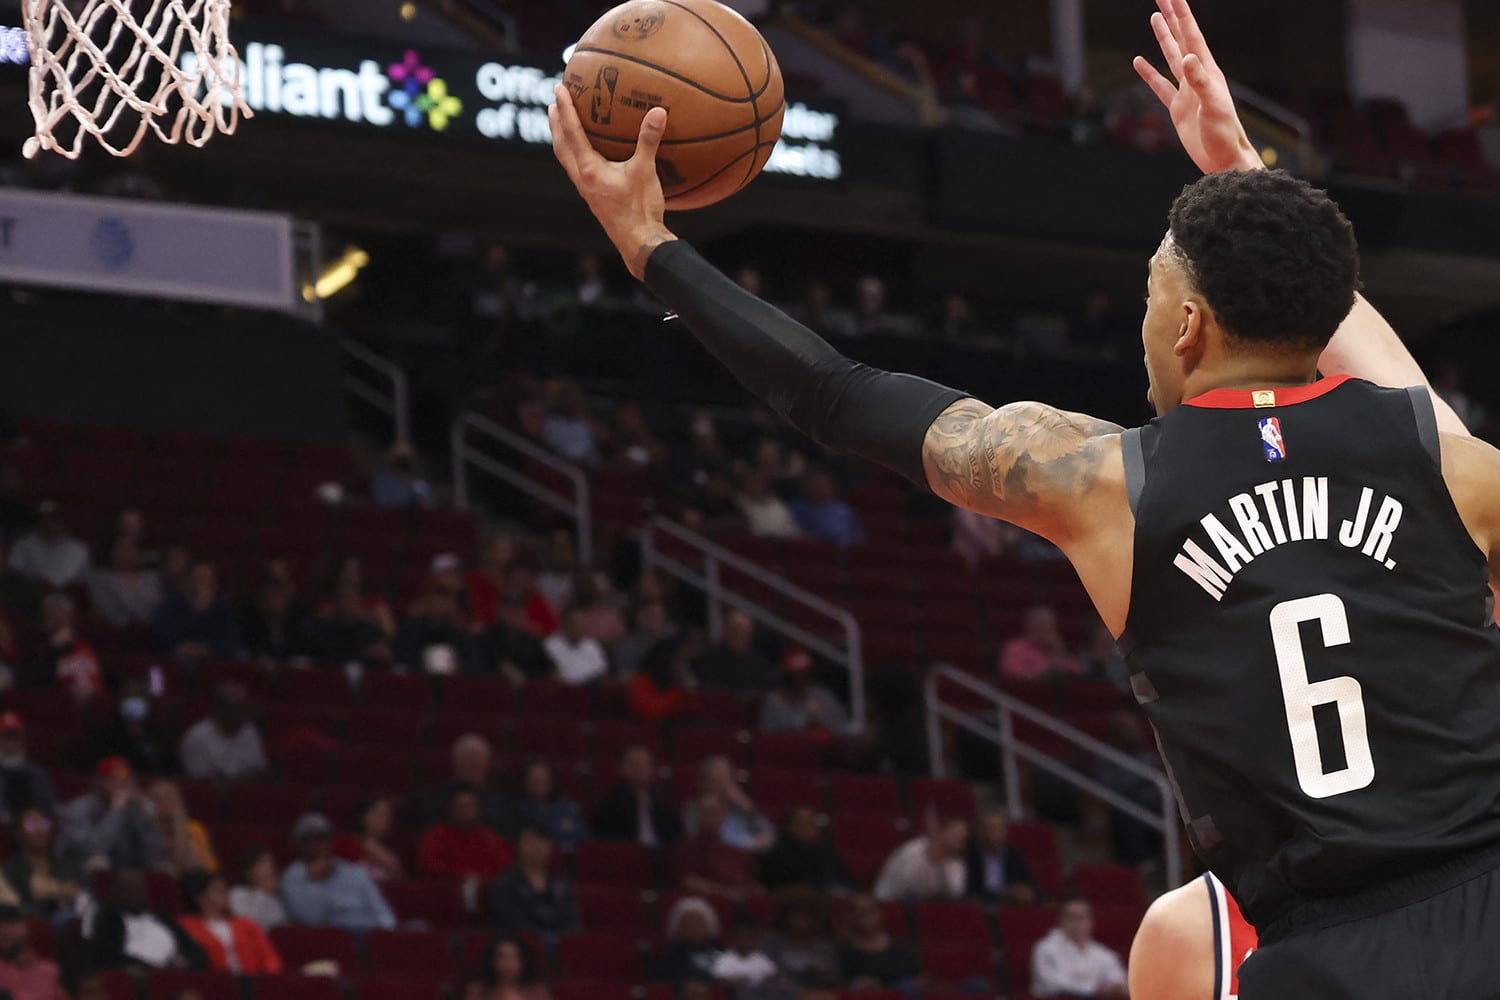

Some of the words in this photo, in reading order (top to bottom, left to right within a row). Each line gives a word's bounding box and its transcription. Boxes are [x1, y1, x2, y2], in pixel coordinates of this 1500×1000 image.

[1173, 476, 1329, 602] MARTIN
[1338, 486, 1404, 571] JR.
[1269, 592, 1376, 799] 6
